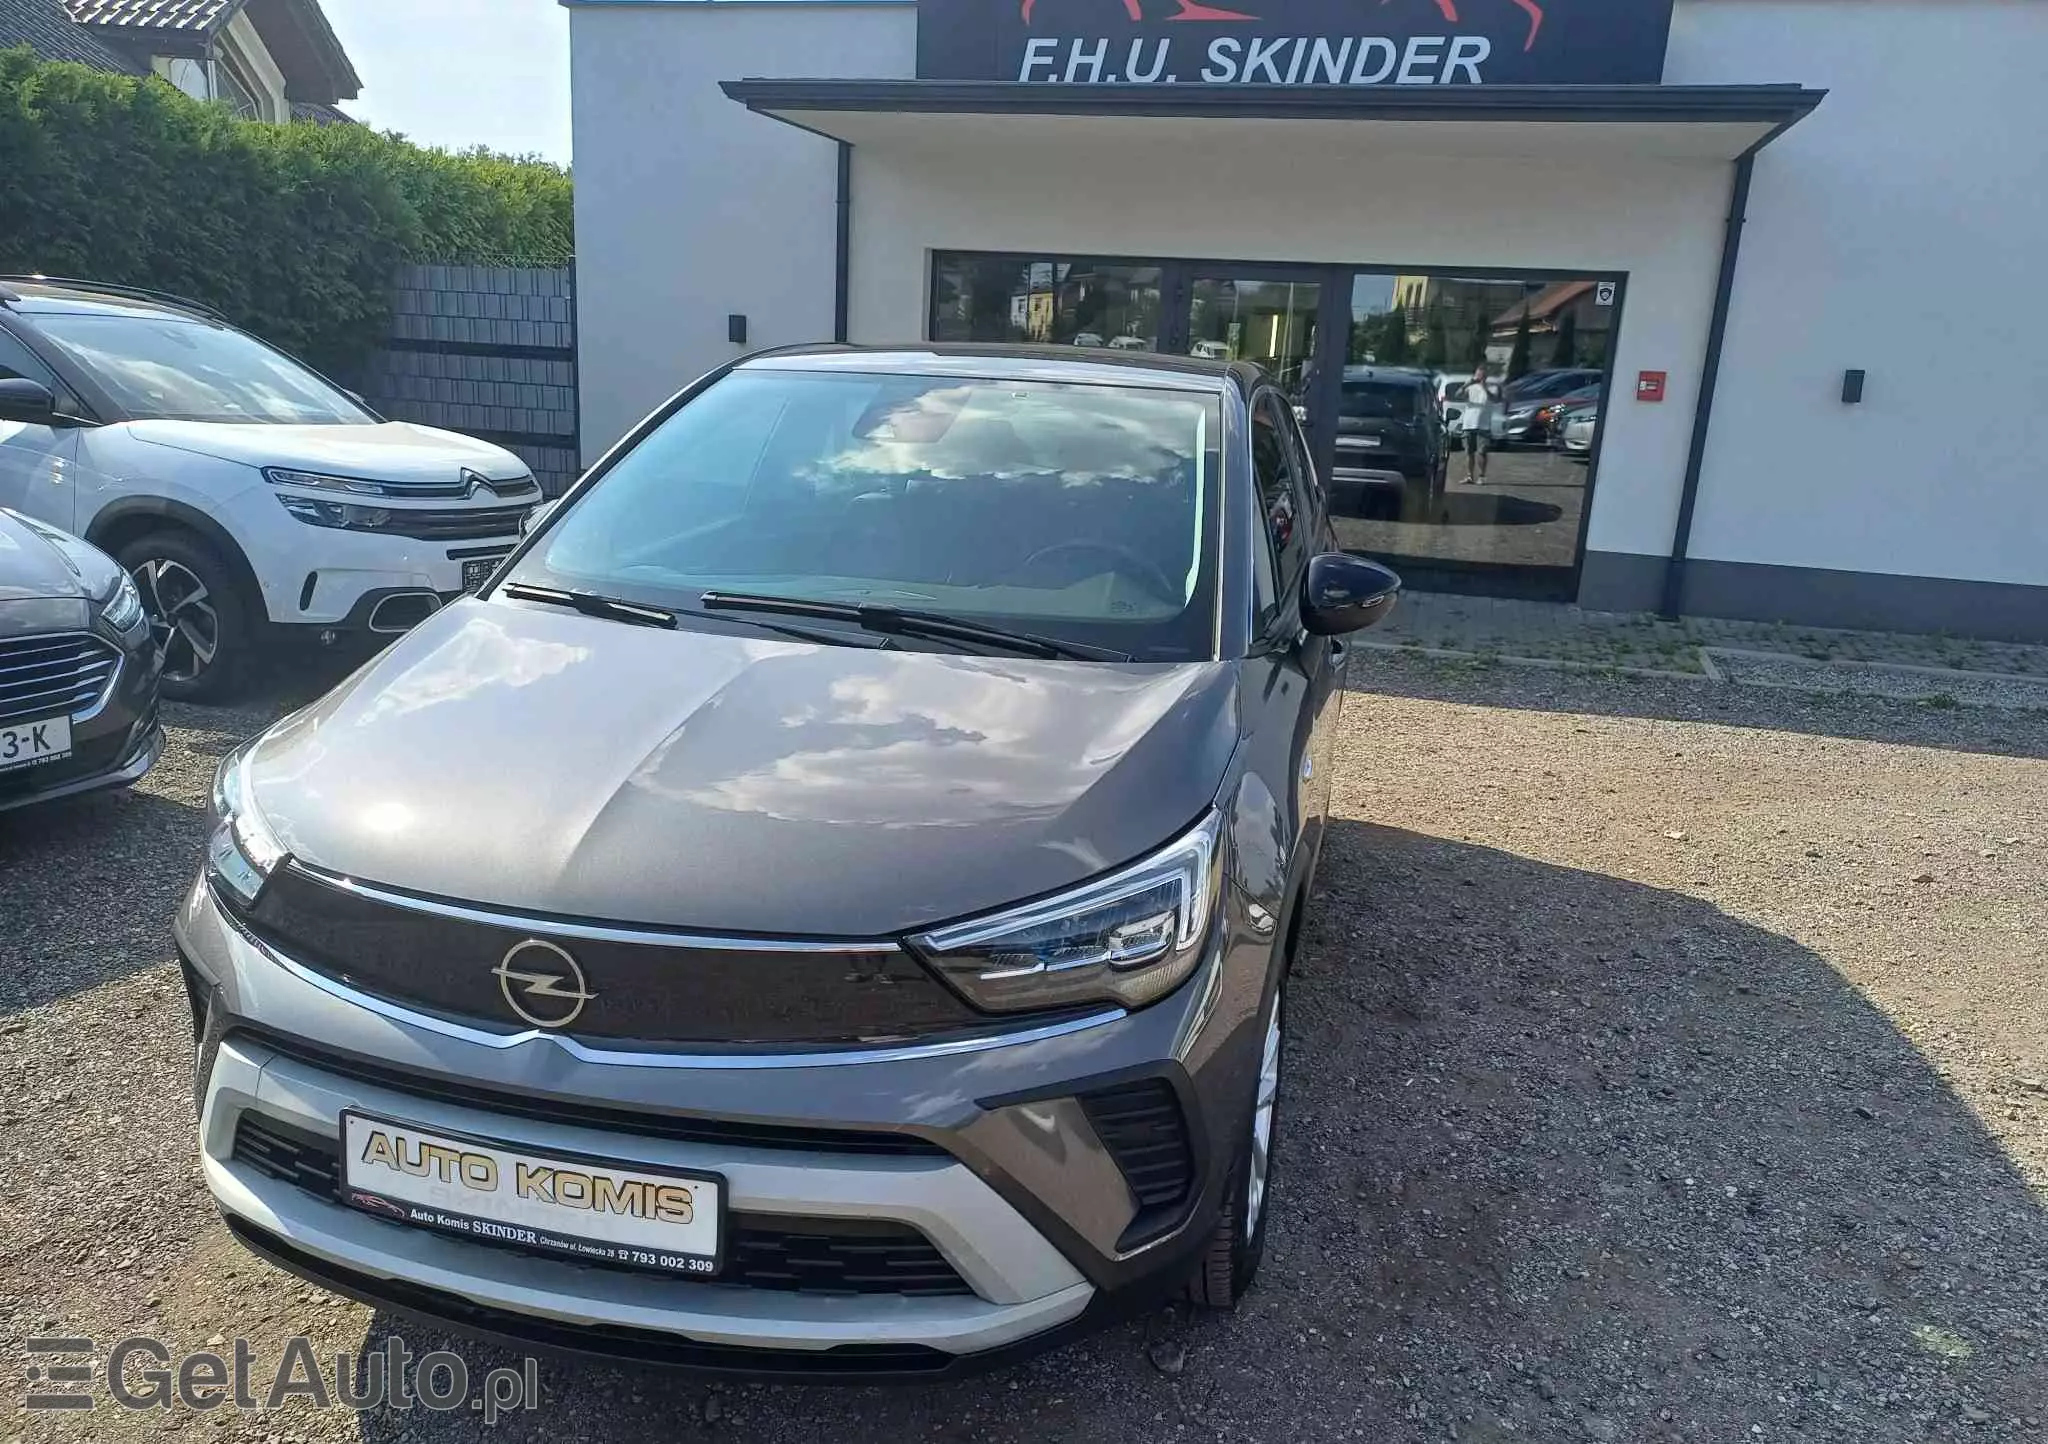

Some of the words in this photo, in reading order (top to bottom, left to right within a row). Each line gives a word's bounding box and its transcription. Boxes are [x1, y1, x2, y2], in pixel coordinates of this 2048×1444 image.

[1018, 37, 1177, 83] F.H.U.
[1200, 36, 1491, 84] SKINDER
[361, 1131, 498, 1191] AUTO
[516, 1162, 694, 1224] KOMIS
[410, 1208, 434, 1223] Auto
[437, 1214, 470, 1230] Komis
[472, 1220, 537, 1244] SKINDER
[631, 1250, 656, 1266] 793
[659, 1255, 685, 1270] 002
[688, 1259, 714, 1273] 309
